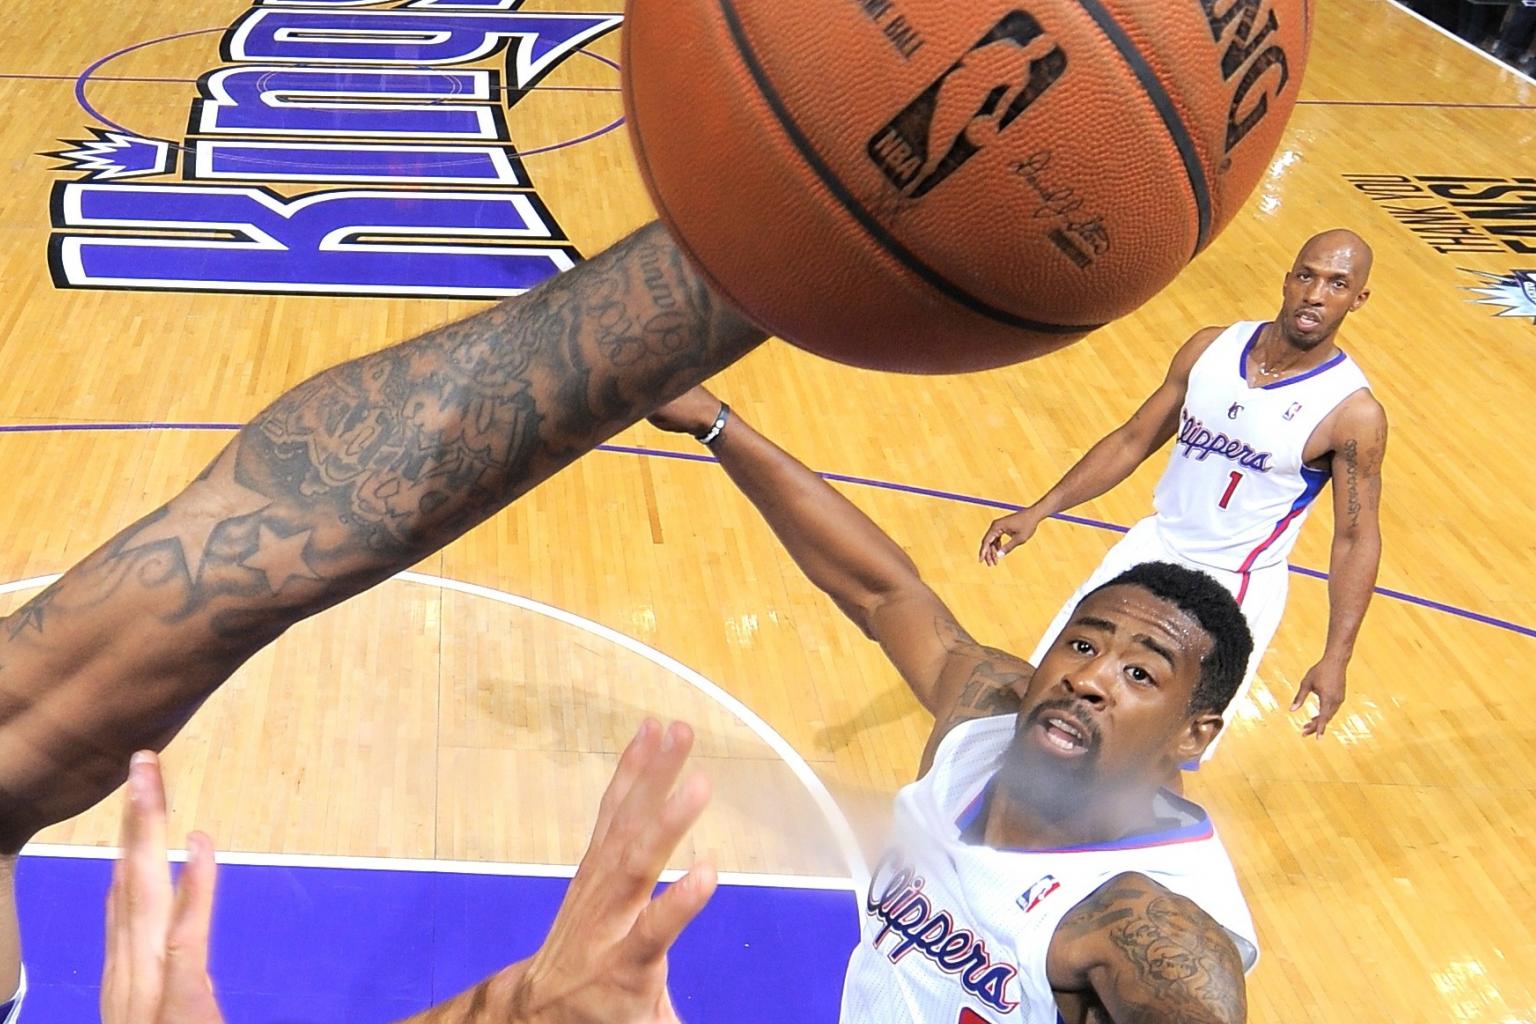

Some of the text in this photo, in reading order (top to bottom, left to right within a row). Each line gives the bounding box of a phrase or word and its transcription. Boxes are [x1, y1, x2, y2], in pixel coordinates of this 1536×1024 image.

[873, 128, 921, 183] NBA
[1335, 173, 1507, 255] THANK YOU
[1217, 469, 1244, 510] 1
